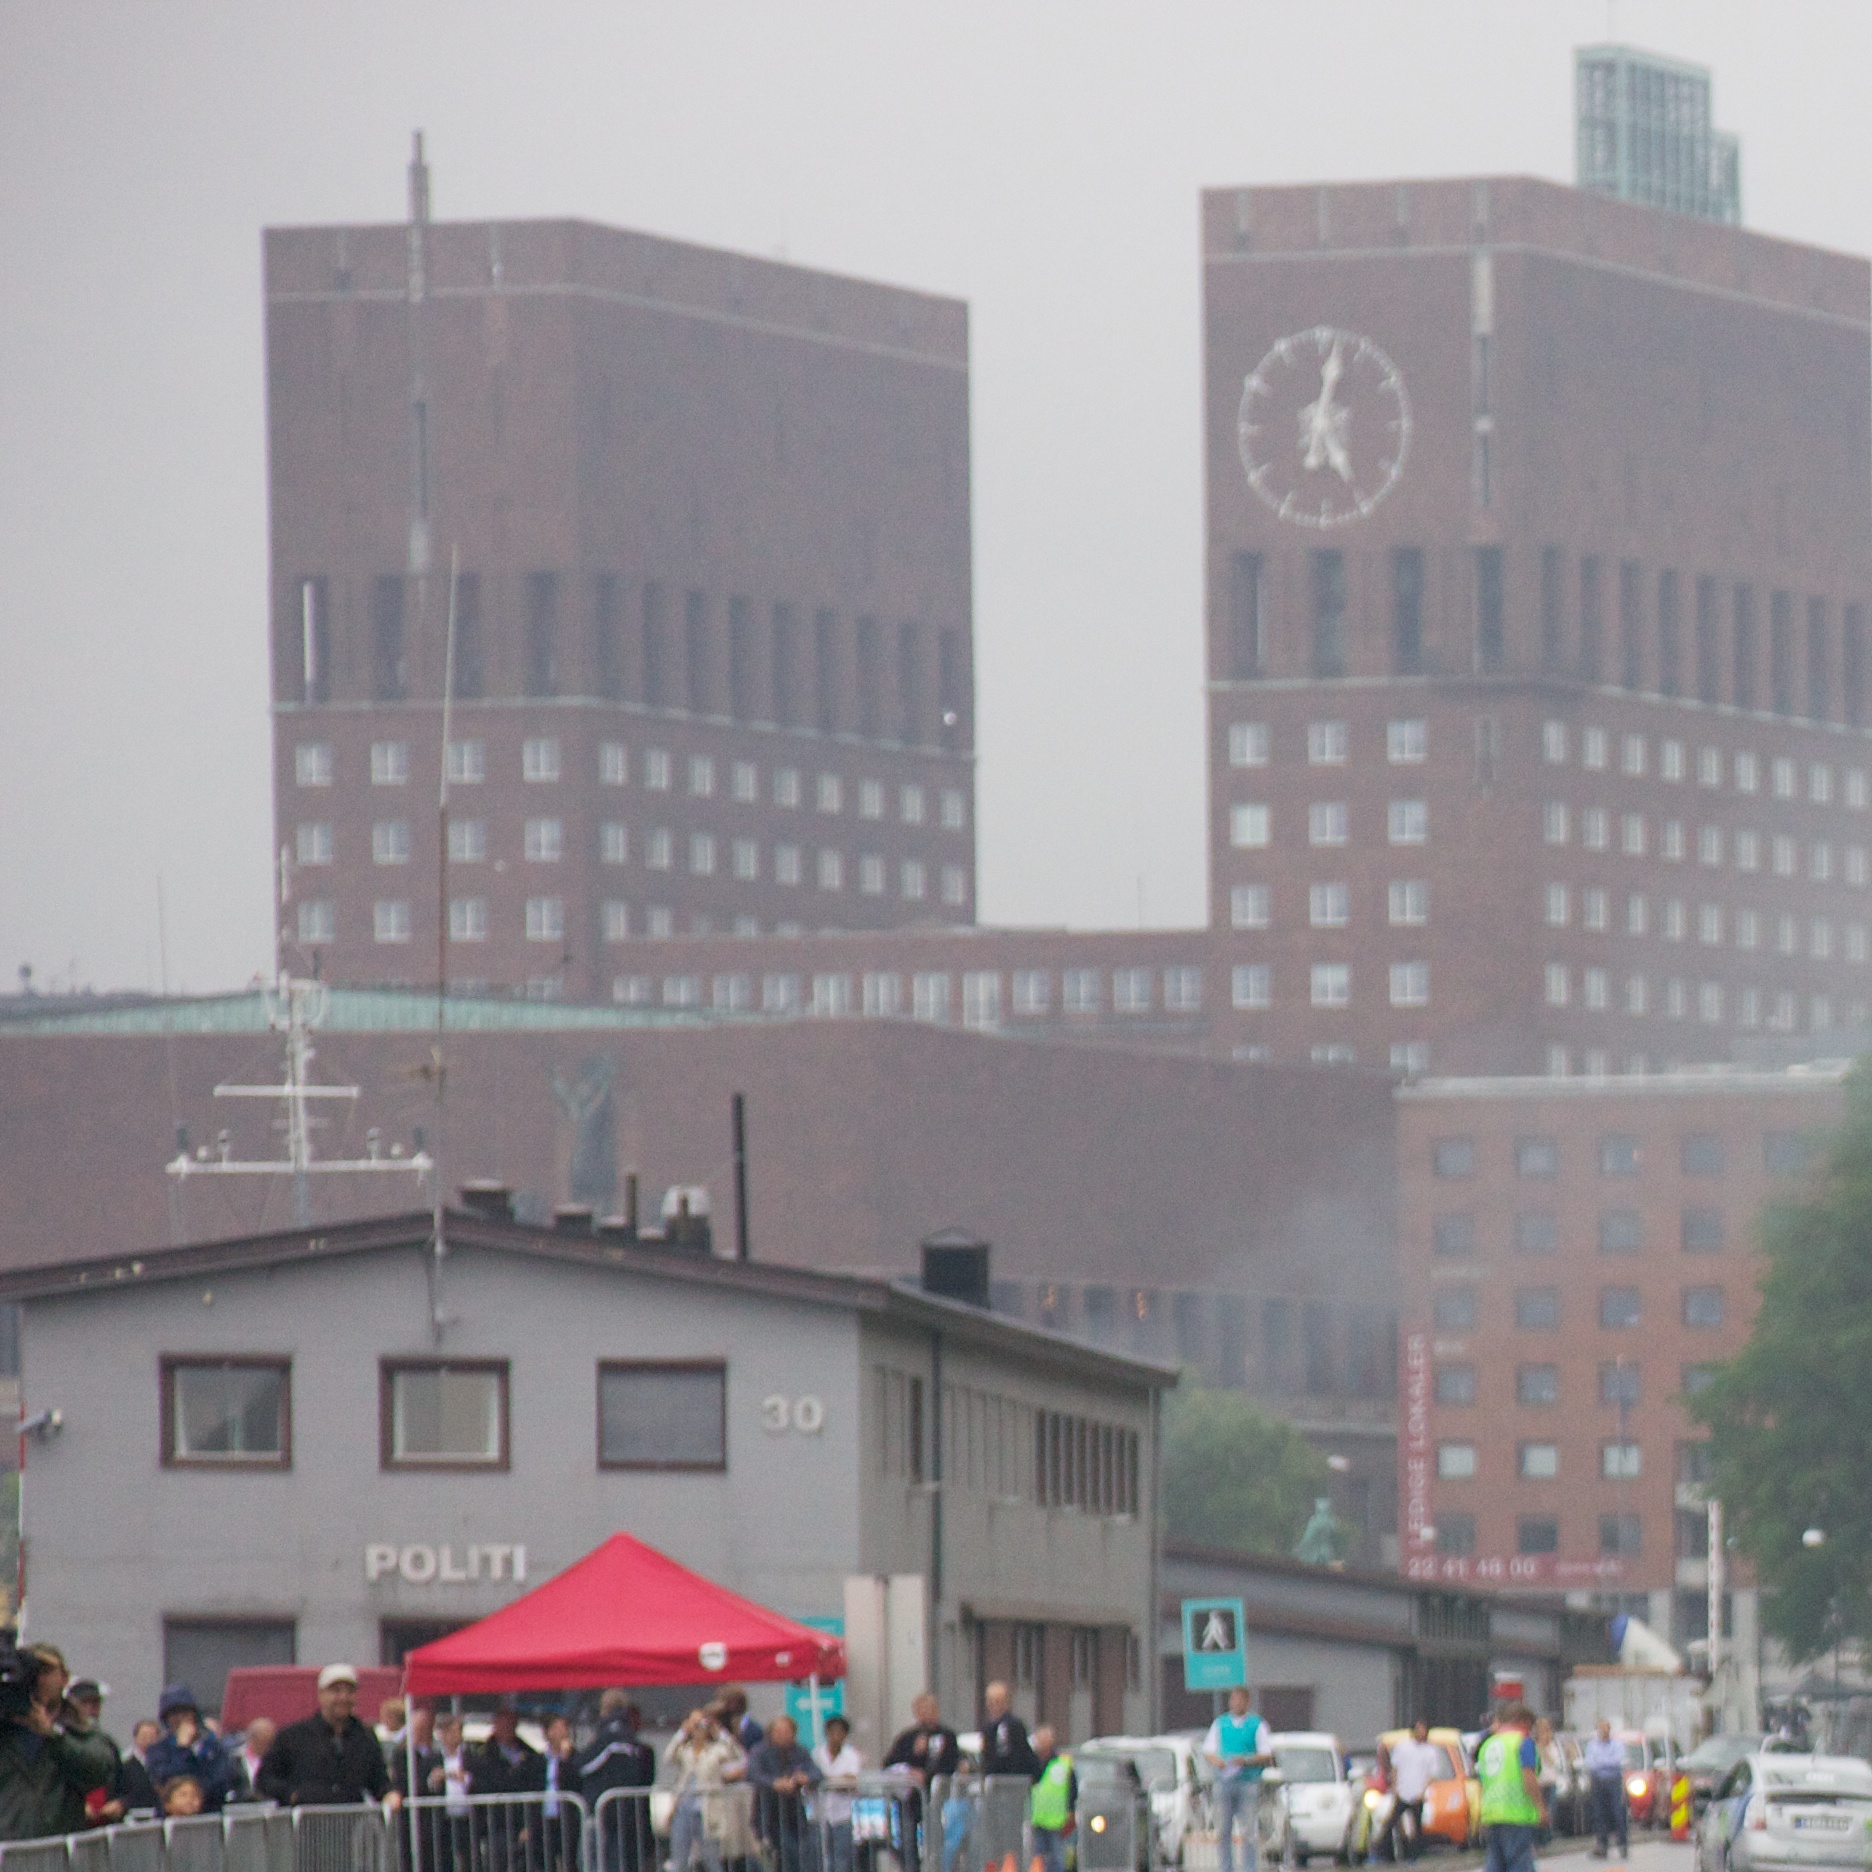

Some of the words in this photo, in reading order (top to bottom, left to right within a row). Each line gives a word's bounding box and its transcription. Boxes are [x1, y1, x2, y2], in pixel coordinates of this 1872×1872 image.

[761, 1394, 827, 1434] 30
[365, 1544, 528, 1583] POLITI
[1408, 1556, 1436, 1578] 22
